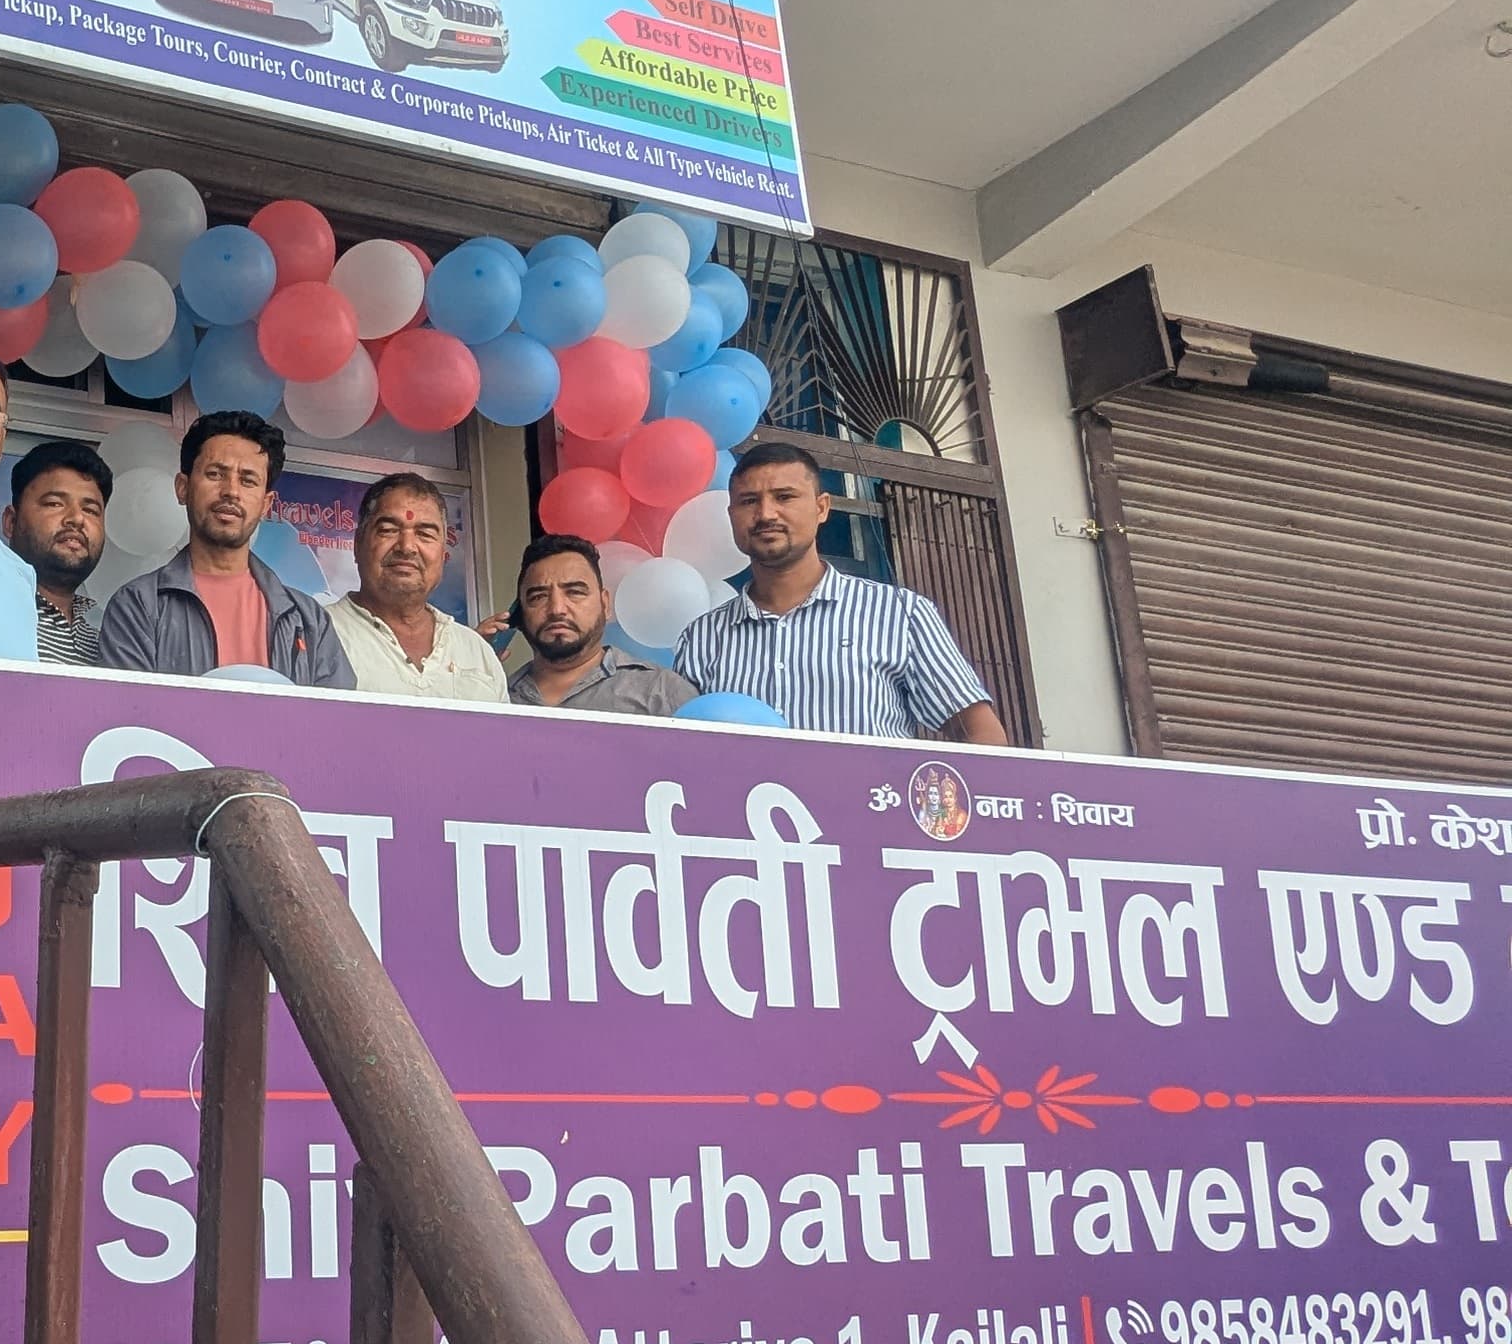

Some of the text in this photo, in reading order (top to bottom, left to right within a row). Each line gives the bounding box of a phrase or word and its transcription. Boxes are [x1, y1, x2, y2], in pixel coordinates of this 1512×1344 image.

[634, 17, 772, 74] Best Services
[711, 6, 767, 38] Drive
[69, 4, 146, 47] Package
[151, 24, 209, 62] Tours,
[213, 40, 287, 80] Courier,
[290, 59, 366, 96] Contract
[371, 78, 387, 100] &
[391, 83, 474, 122] Corporate
[478, 103, 544, 142] Pickups,
[547, 121, 572, 145] Air
[574, 128, 621, 159] Ticket
[625, 140, 639, 161] &
[643, 145, 664, 168] All
[666, 150, 702, 179] Type
[703, 158, 754, 188] Vehicle
[559, 72, 783, 148] Experienced Drivers
[599, 46, 778, 110] Affordable Price
[868, 783, 901, 812] ॐ
[1050, 792, 1135, 828] शिवाय
[1356, 798, 1417, 849] प्रो.
[443, 780, 843, 1020] पार्वती
[881, 849, 1231, 1070] ट्राभल
[1257, 869, 1475, 1027] एण्ड
[960, 1141, 1331, 1258] Travels
[1360, 1138, 1437, 1247] &
[1449, 1140, 1512, 1243] T
